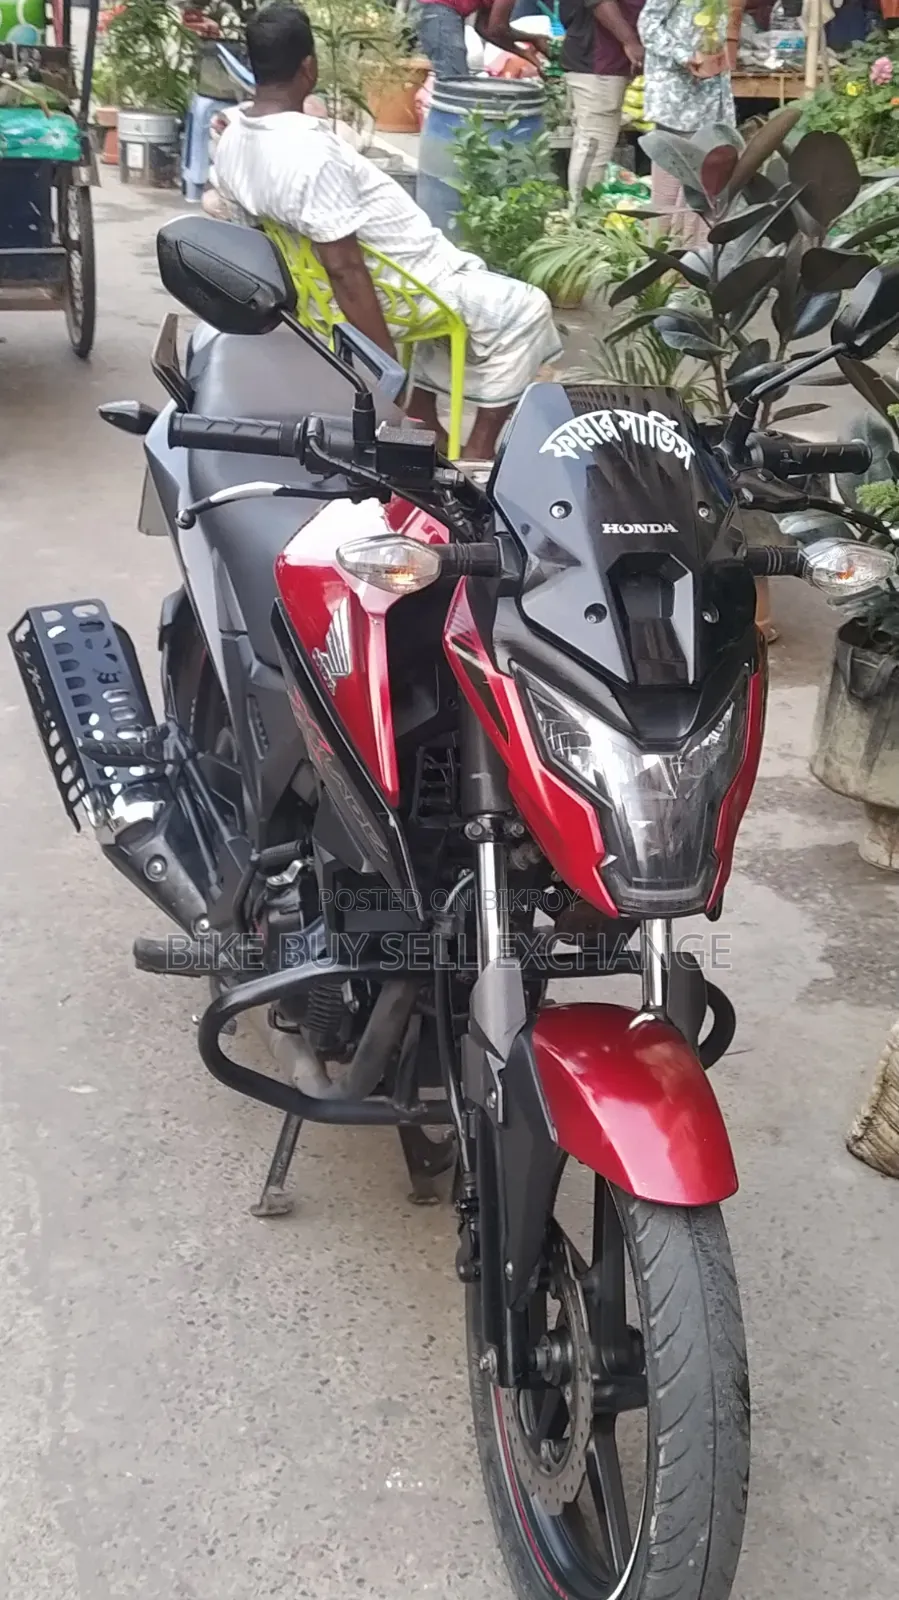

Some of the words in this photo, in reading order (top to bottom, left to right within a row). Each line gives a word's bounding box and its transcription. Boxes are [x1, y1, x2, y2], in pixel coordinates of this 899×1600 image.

[539, 409, 622, 460] ফায়ার
[612, 408, 696, 471] সার্ভিস
[601, 522, 679, 535] HONDA
